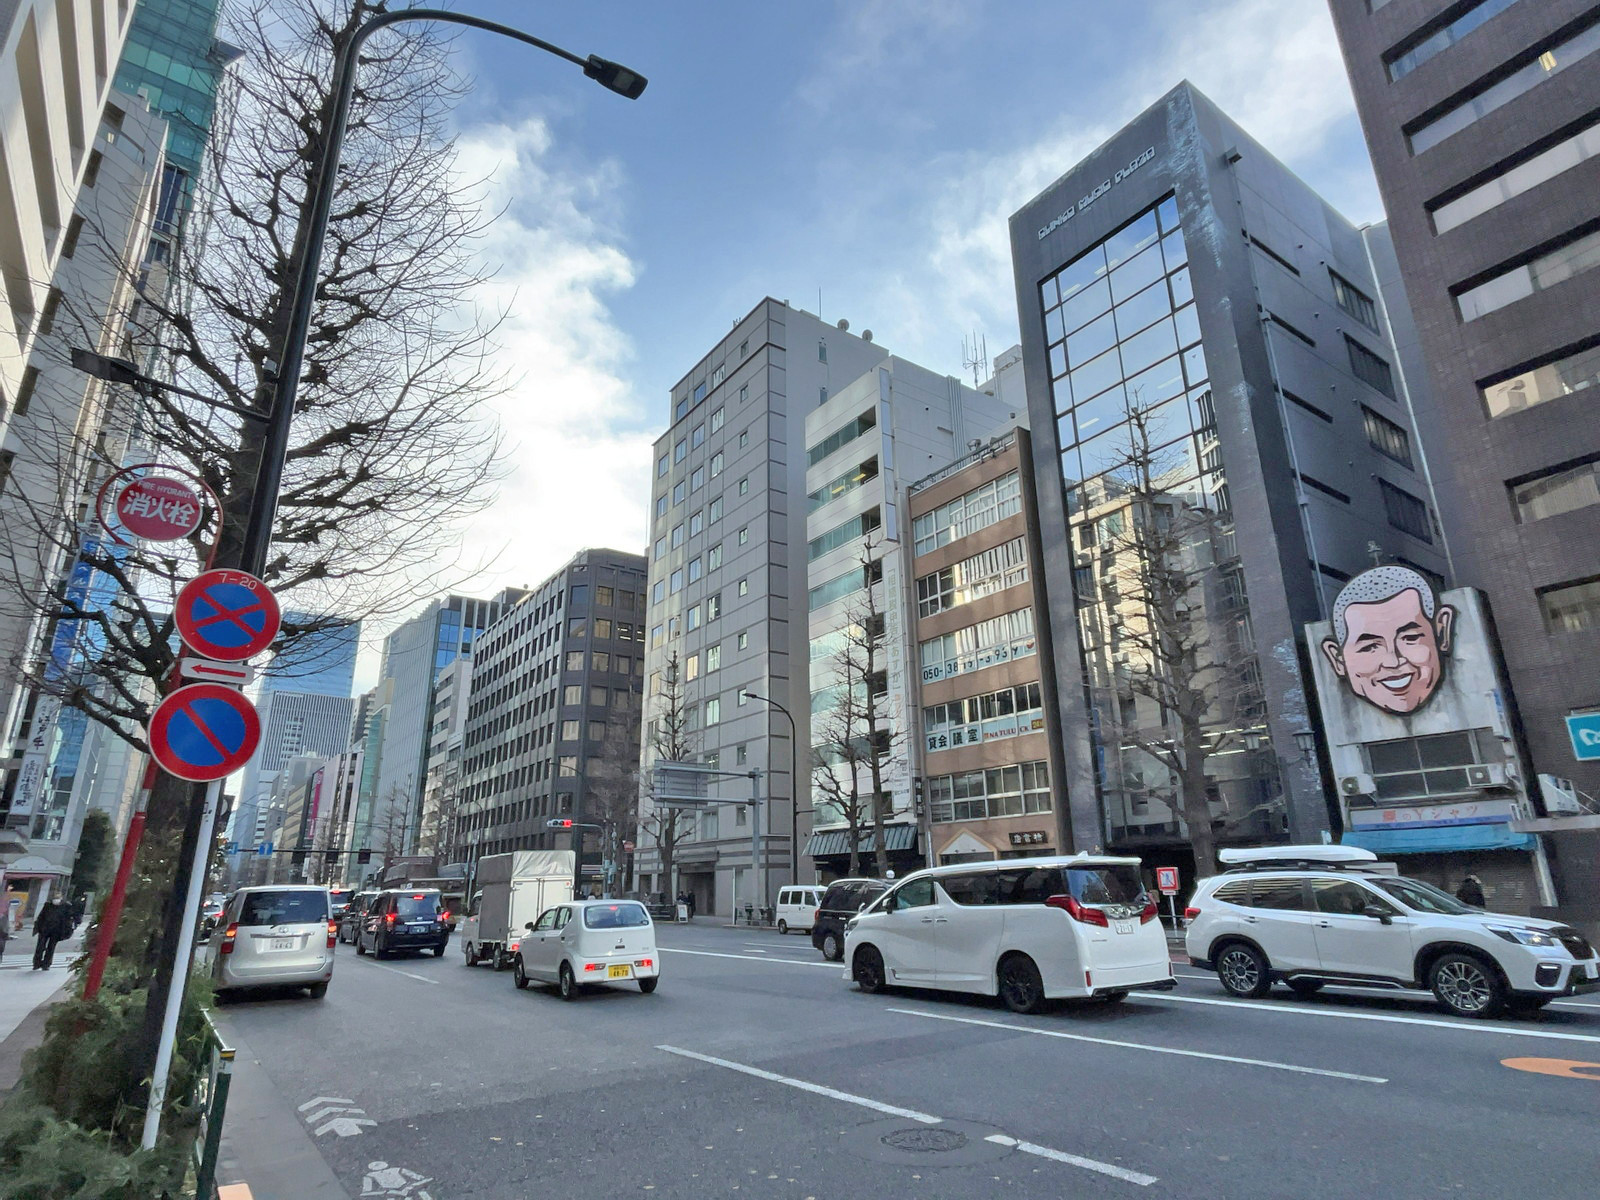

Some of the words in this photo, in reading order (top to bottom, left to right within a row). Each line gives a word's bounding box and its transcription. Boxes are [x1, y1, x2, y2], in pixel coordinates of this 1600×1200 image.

[1114, 146, 1155, 183] PLAZA
[137, 480, 155, 493] FIRE
[156, 484, 193, 499] HYDRANT
[122, 490, 196, 527] 消火栓
[218, 573, 258, 590] 7-20
[928, 729, 978, 750] 貸会議室
